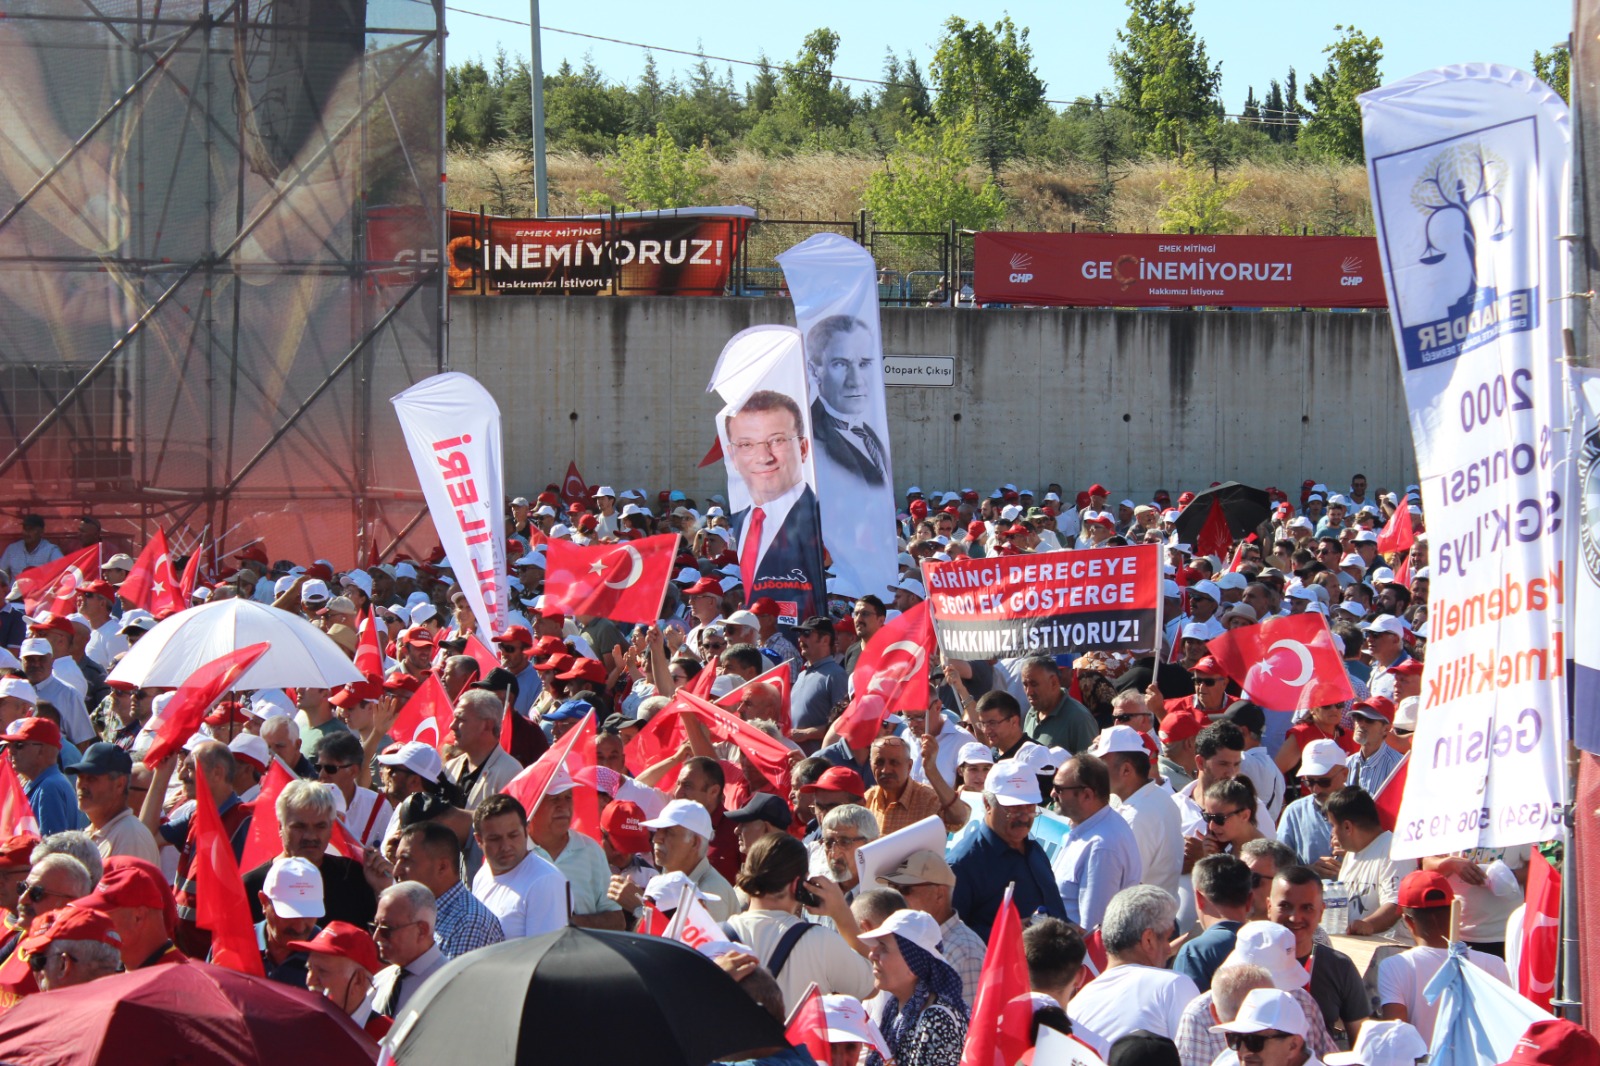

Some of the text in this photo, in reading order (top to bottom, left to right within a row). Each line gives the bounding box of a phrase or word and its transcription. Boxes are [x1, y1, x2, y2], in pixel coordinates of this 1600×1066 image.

[555, 227, 603, 237] MİTİNG
[1158, 244, 1216, 253] EMEK MİTİNGİ
[1082, 254, 1293, 291] GEÇİNEMİYORUZ!
[1009, 273, 1034, 283] CHP
[1340, 276, 1363, 286] CHP
[1190, 287, 1224, 296] İstiyoruz
[884, 365, 952, 376] Otopark Çıkışı
[932, 557, 1137, 588] BİRİNCİ DERECEYE
[941, 582, 1135, 616] 3600 EK GÖSTERGE
[942, 619, 1140, 653] HAKKIMIZI İSTİYORUZ!
